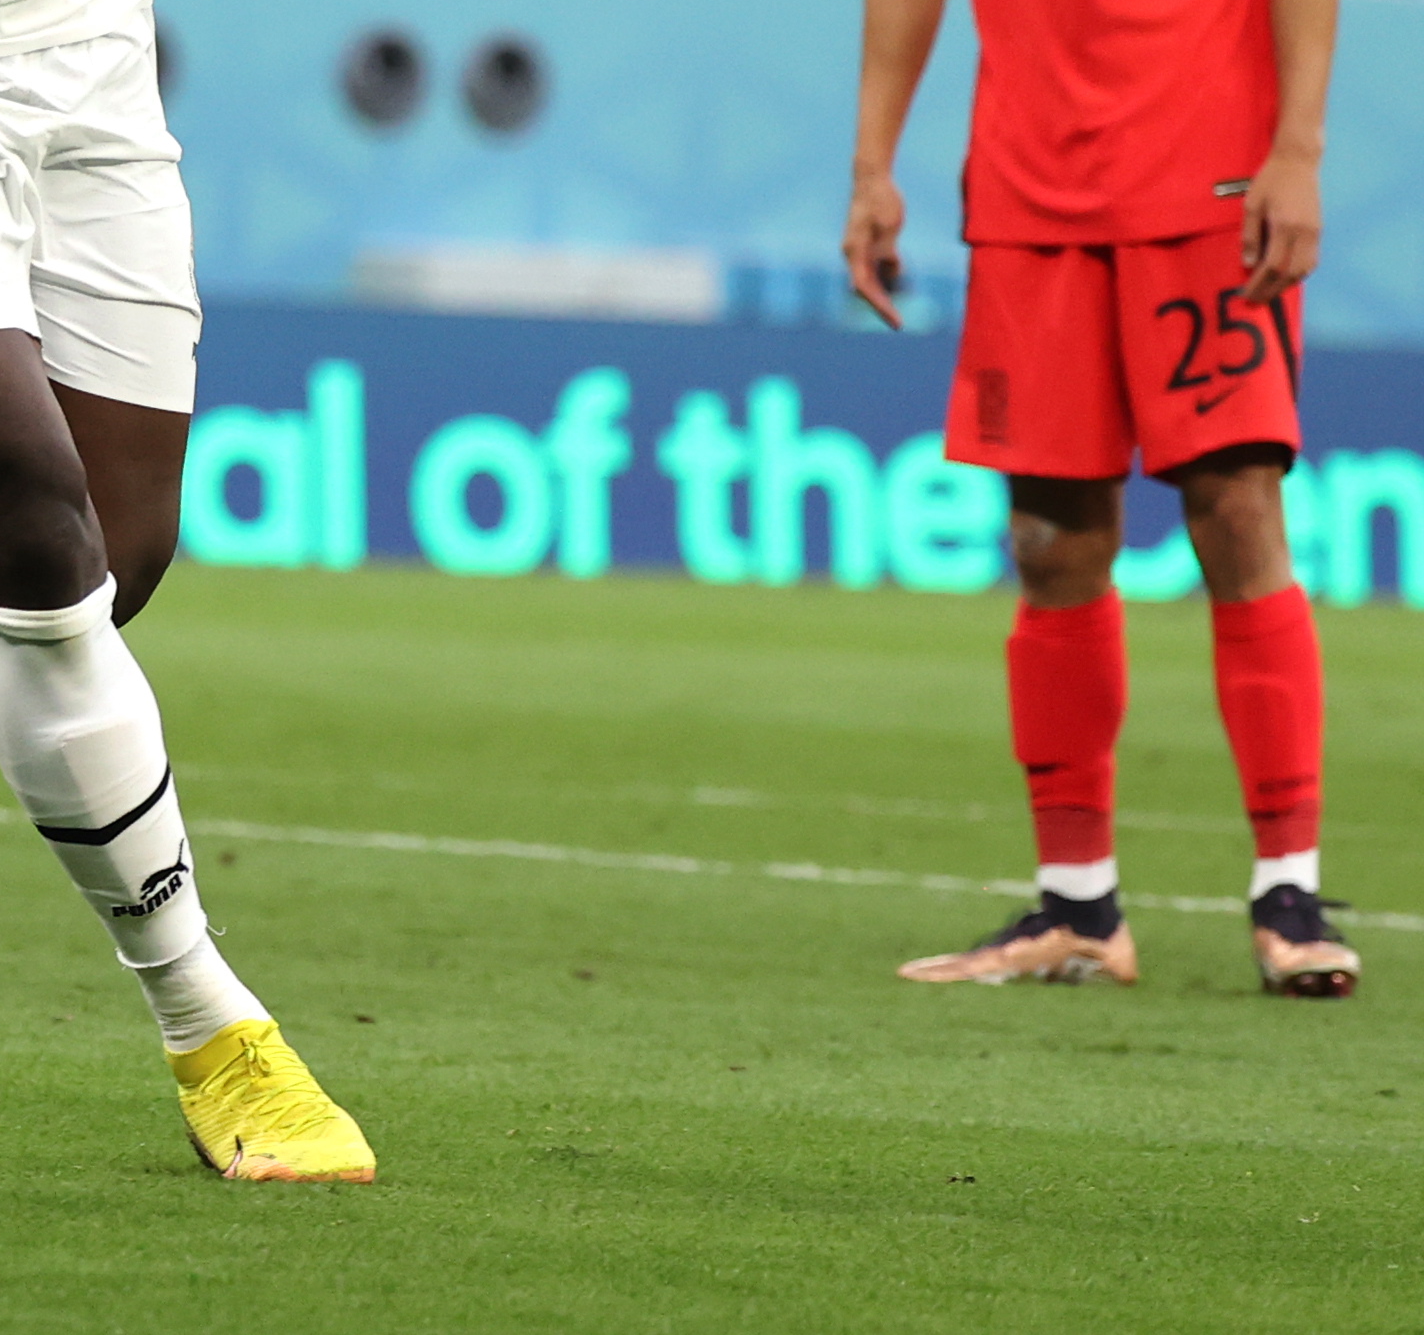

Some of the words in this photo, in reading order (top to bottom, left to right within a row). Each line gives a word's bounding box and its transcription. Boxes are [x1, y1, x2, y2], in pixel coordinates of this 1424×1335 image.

[1156, 287, 1266, 391] 25
[409, 365, 633, 579] of
[657, 373, 1012, 596] the
[112, 873, 183, 918] PUMA
